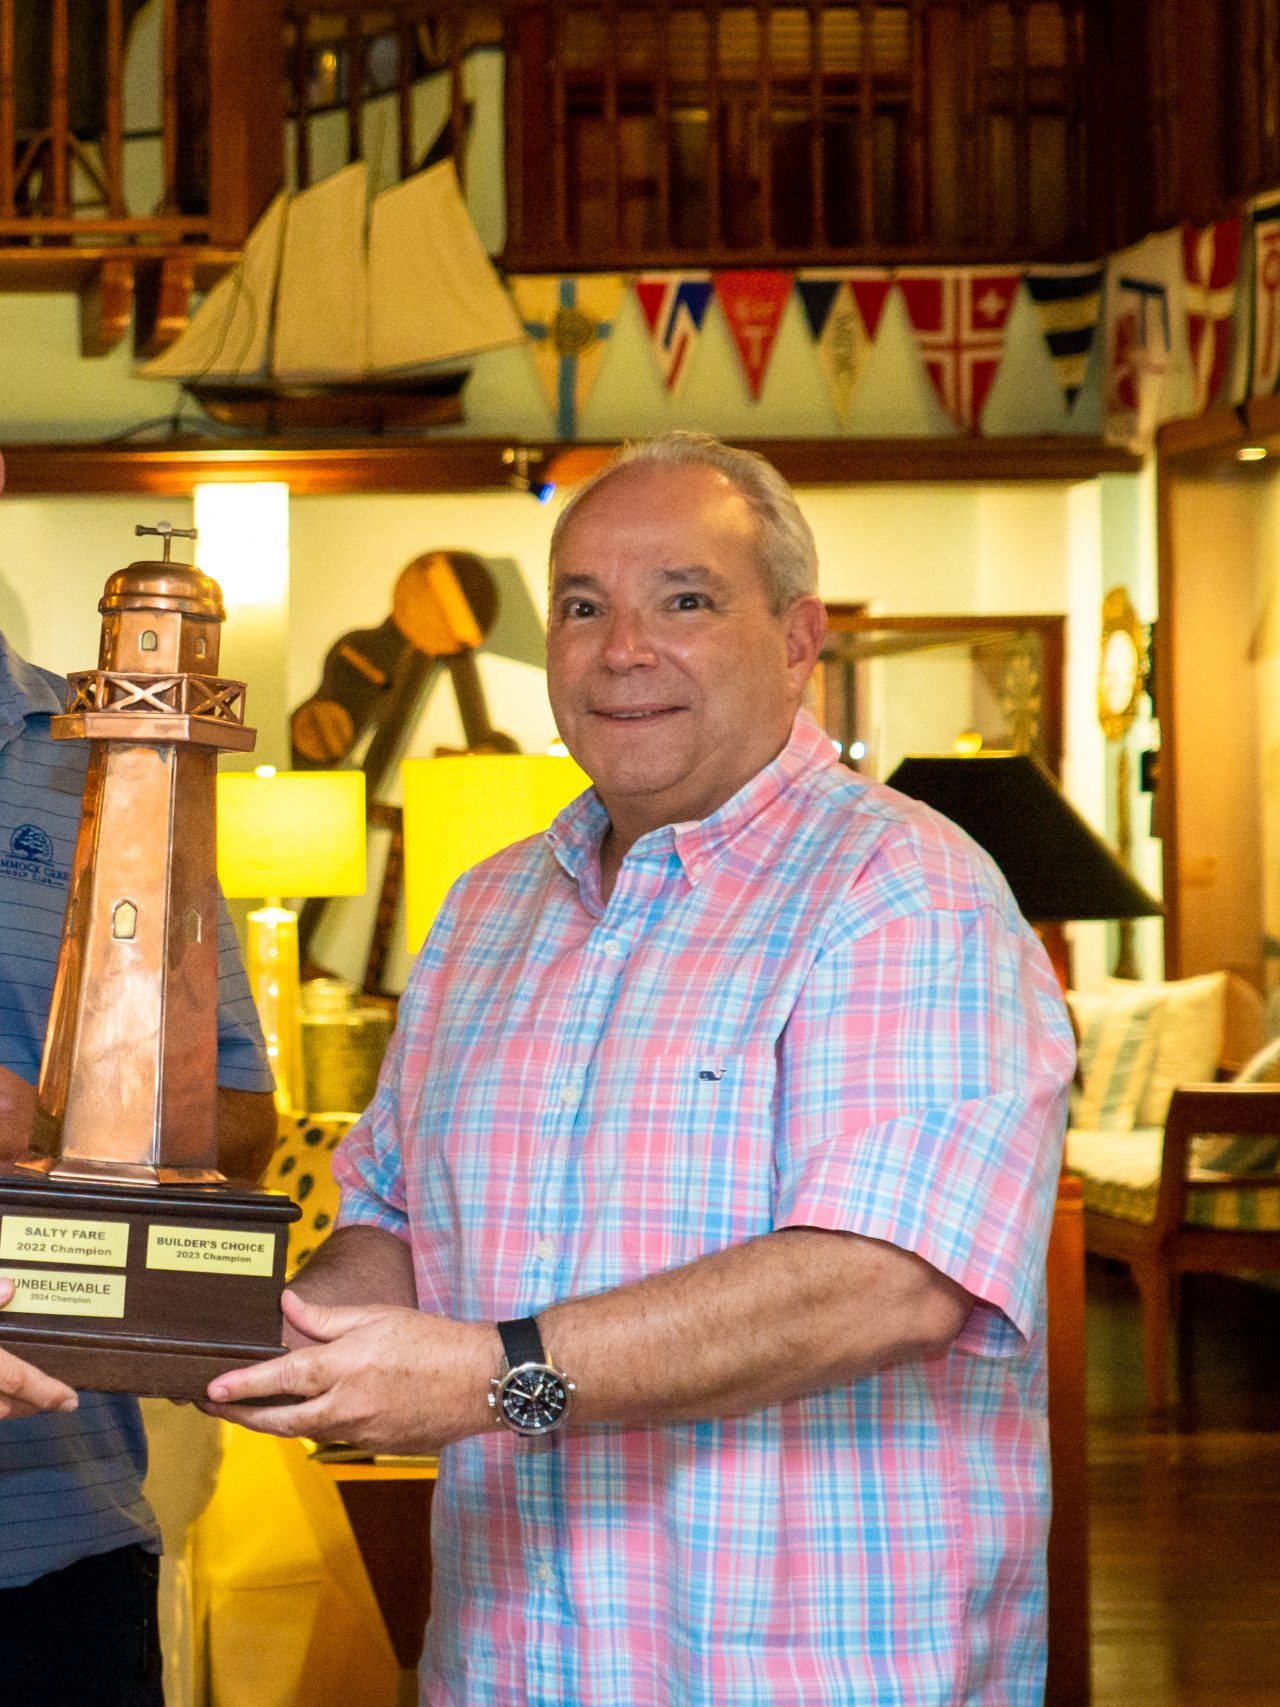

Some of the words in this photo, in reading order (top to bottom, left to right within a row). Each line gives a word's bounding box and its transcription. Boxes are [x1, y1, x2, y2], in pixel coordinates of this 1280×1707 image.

[25, 1226, 68, 1238] SALTY
[72, 1230, 106, 1241] FARE
[16, 1242, 47, 1253] 2022
[50, 1244, 112, 1257] Champion
[156, 1237, 217, 1249] BUILDER'S
[221, 1241, 265, 1253] CHOICE
[176, 1250, 200, 1259] 2023
[203, 1252, 252, 1263] Champion
[30, 1293, 49, 1301] 2024
[51, 1294, 91, 1304] Champion
